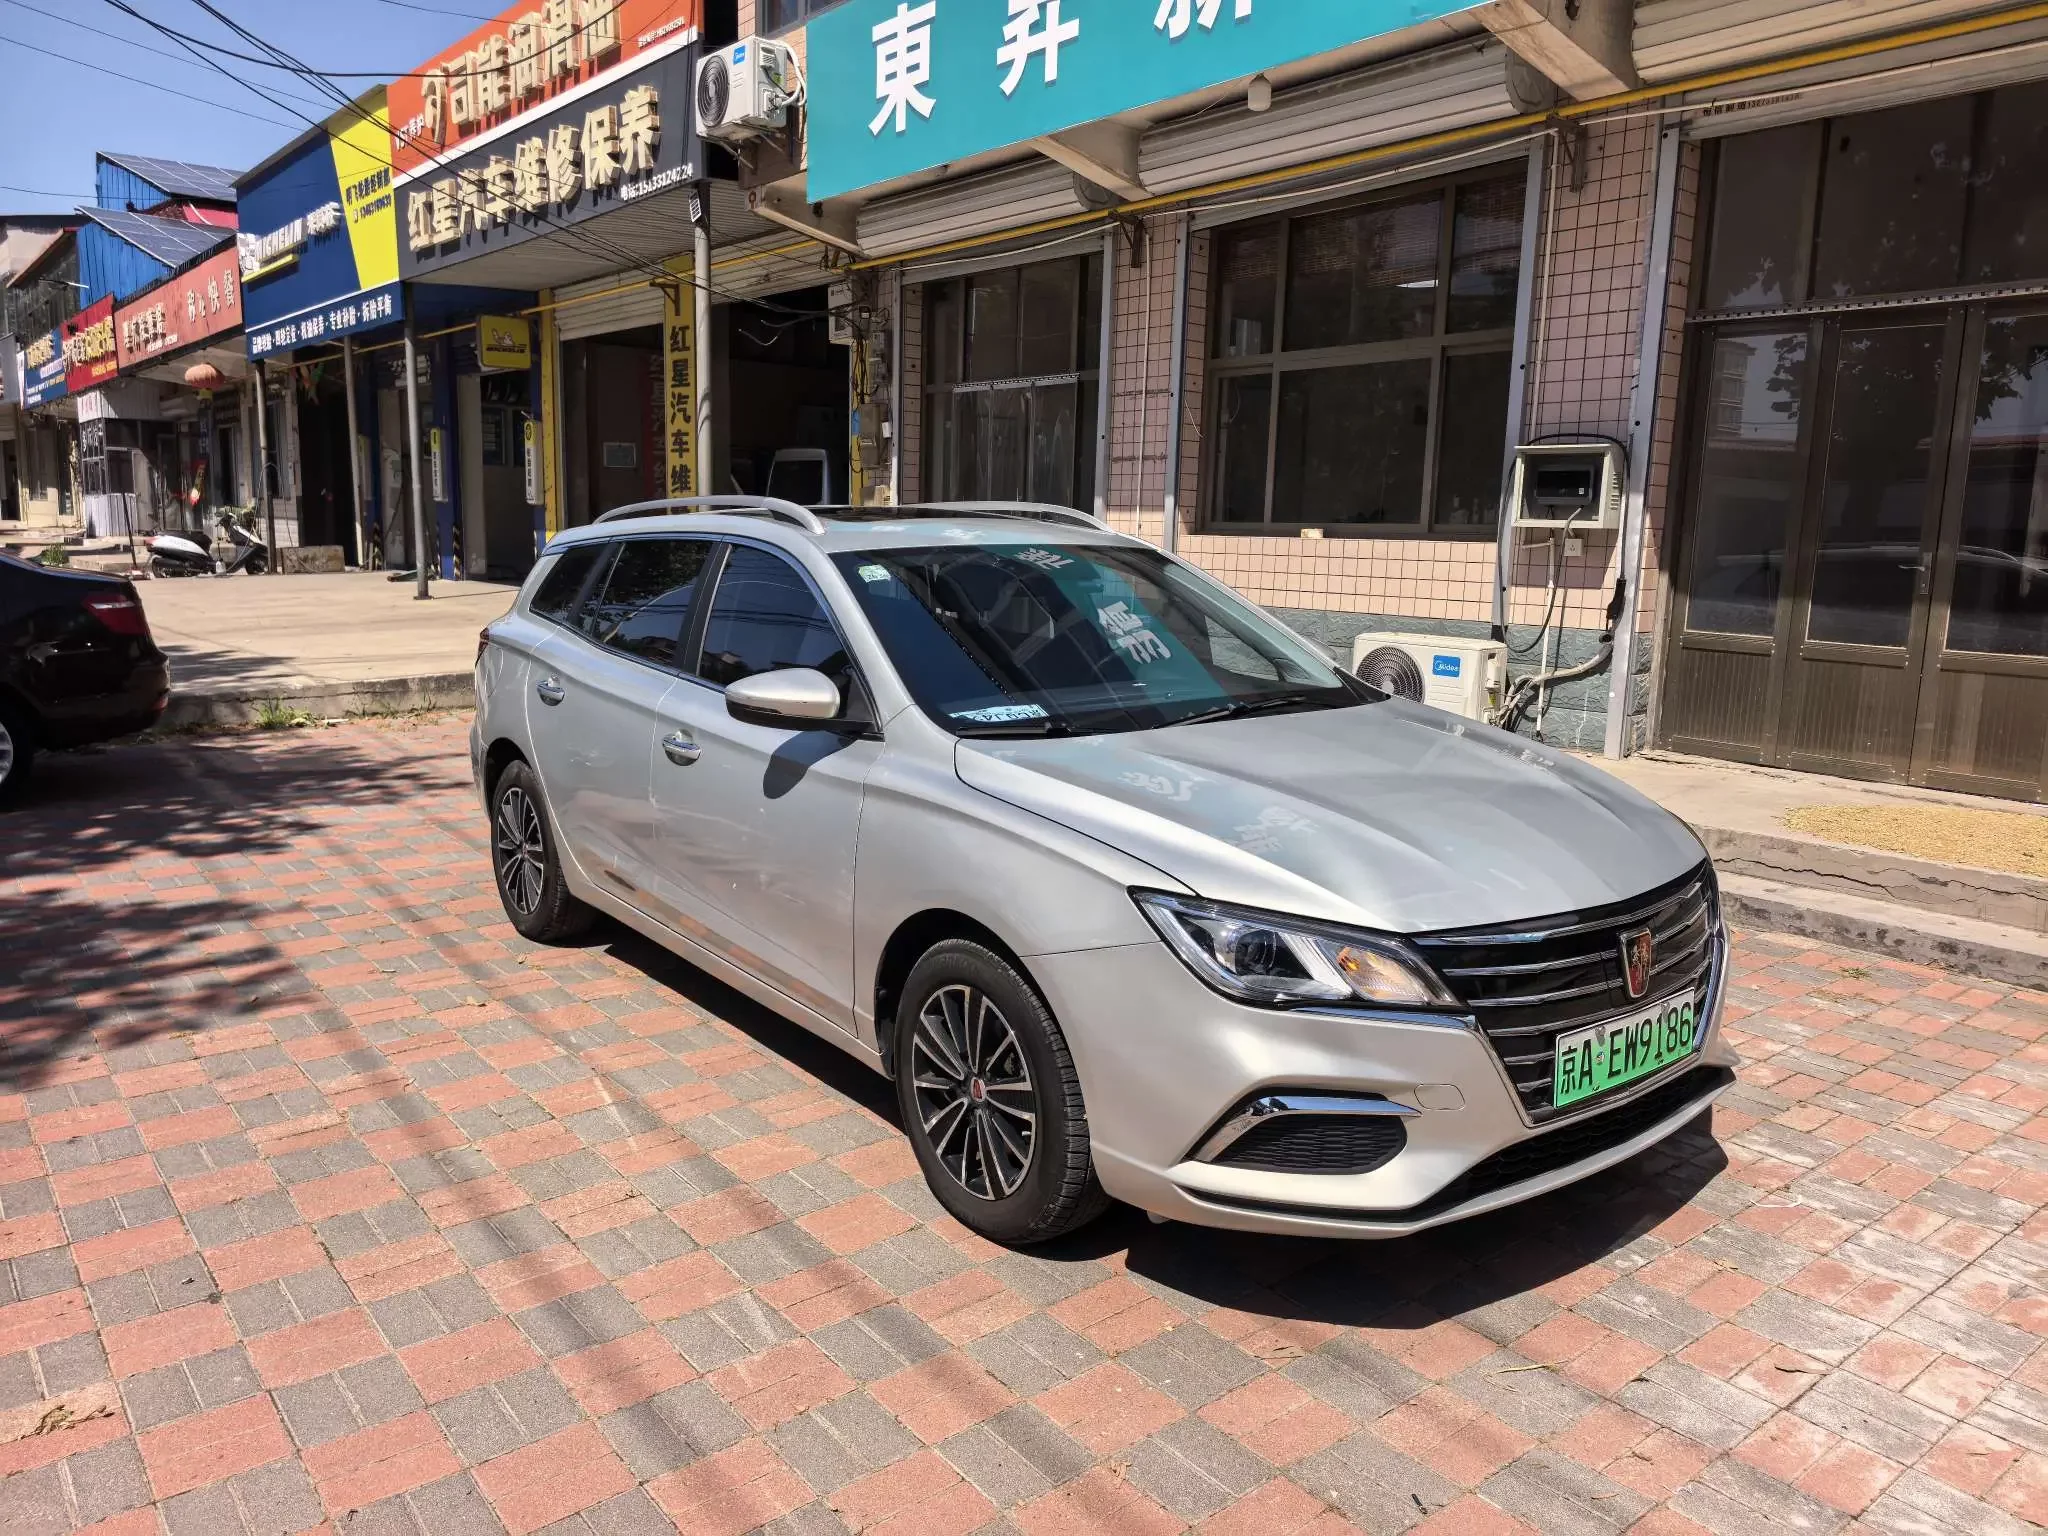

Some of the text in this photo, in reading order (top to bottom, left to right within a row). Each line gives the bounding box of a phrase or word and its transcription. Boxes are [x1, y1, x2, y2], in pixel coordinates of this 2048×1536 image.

[409, 85, 661, 251] 红星汽车维修保养
[669, 325, 692, 513] 红星汽车维
